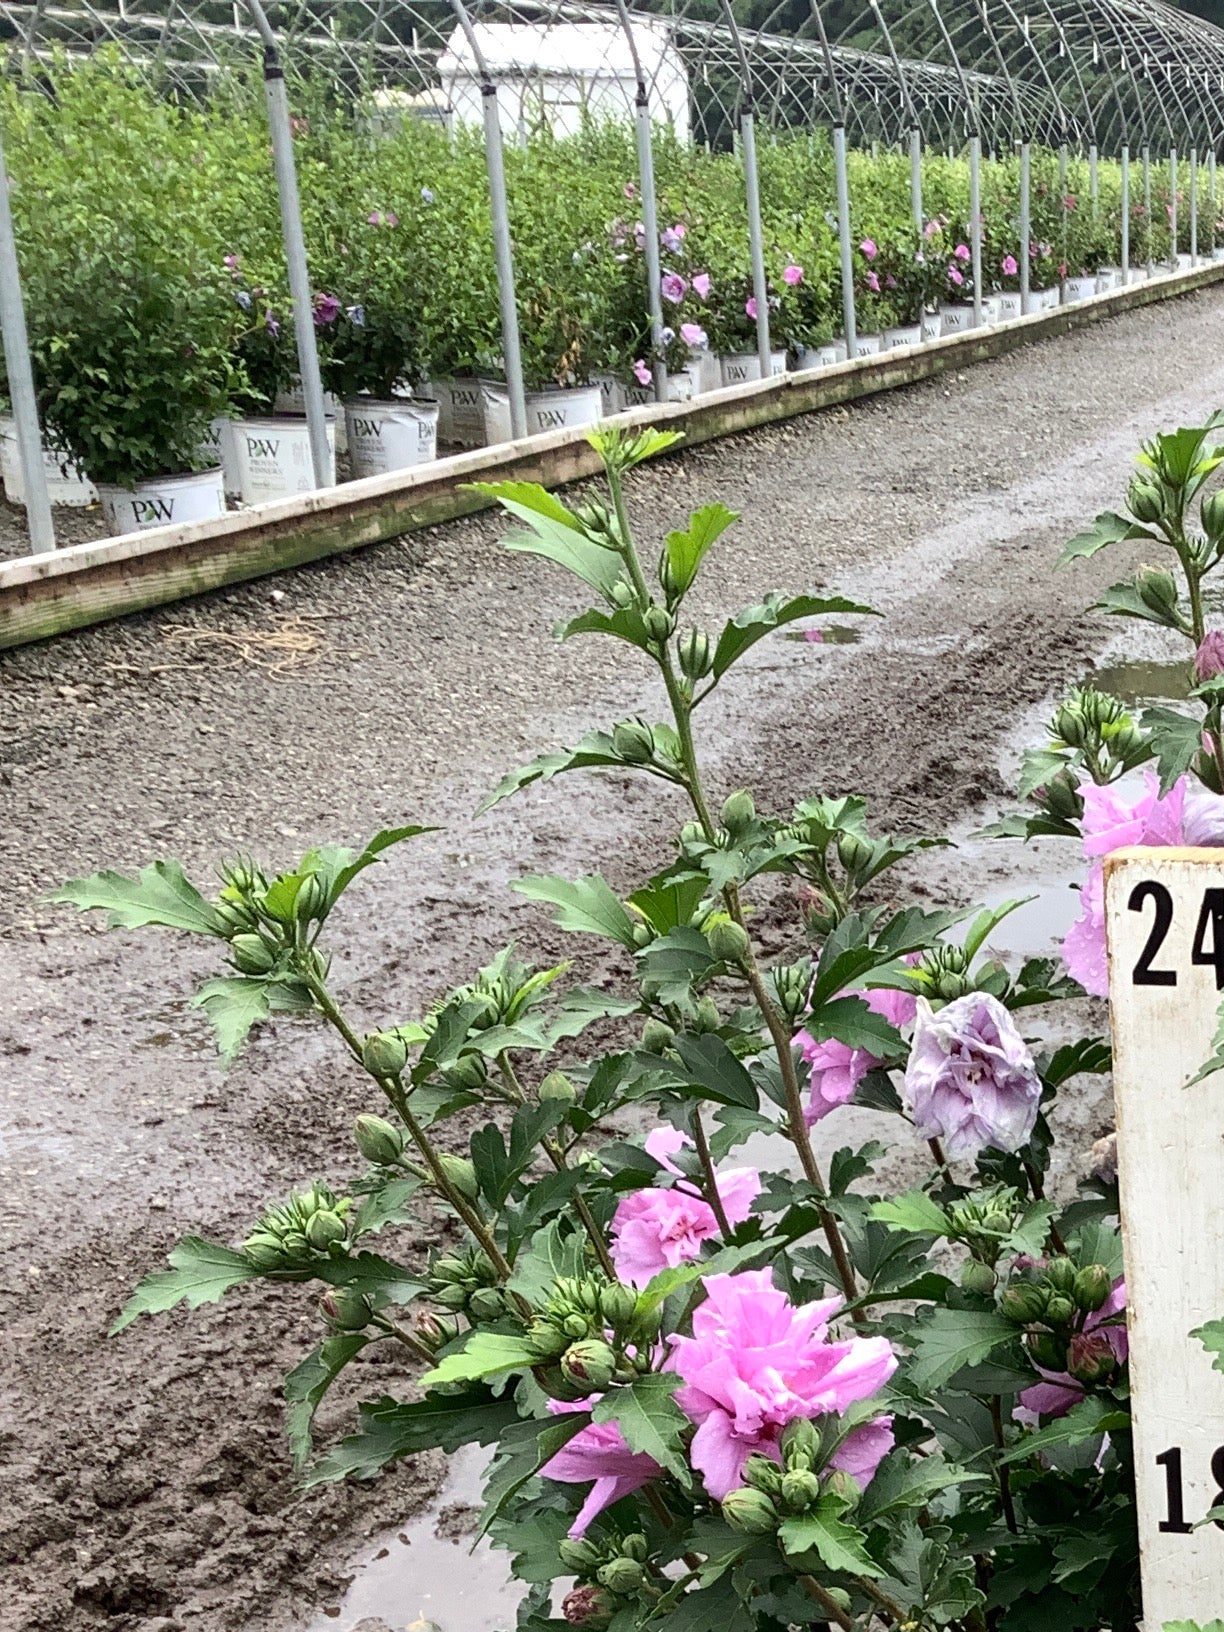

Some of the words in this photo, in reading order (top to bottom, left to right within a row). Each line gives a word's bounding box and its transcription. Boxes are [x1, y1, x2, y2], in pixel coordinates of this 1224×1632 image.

[727, 365, 747, 380] PW
[449, 389, 480, 406] PW
[353, 418, 384, 437] PW
[537, 409, 567, 428] PW
[247, 437, 280, 458] PW
[131, 498, 175, 523] PW
